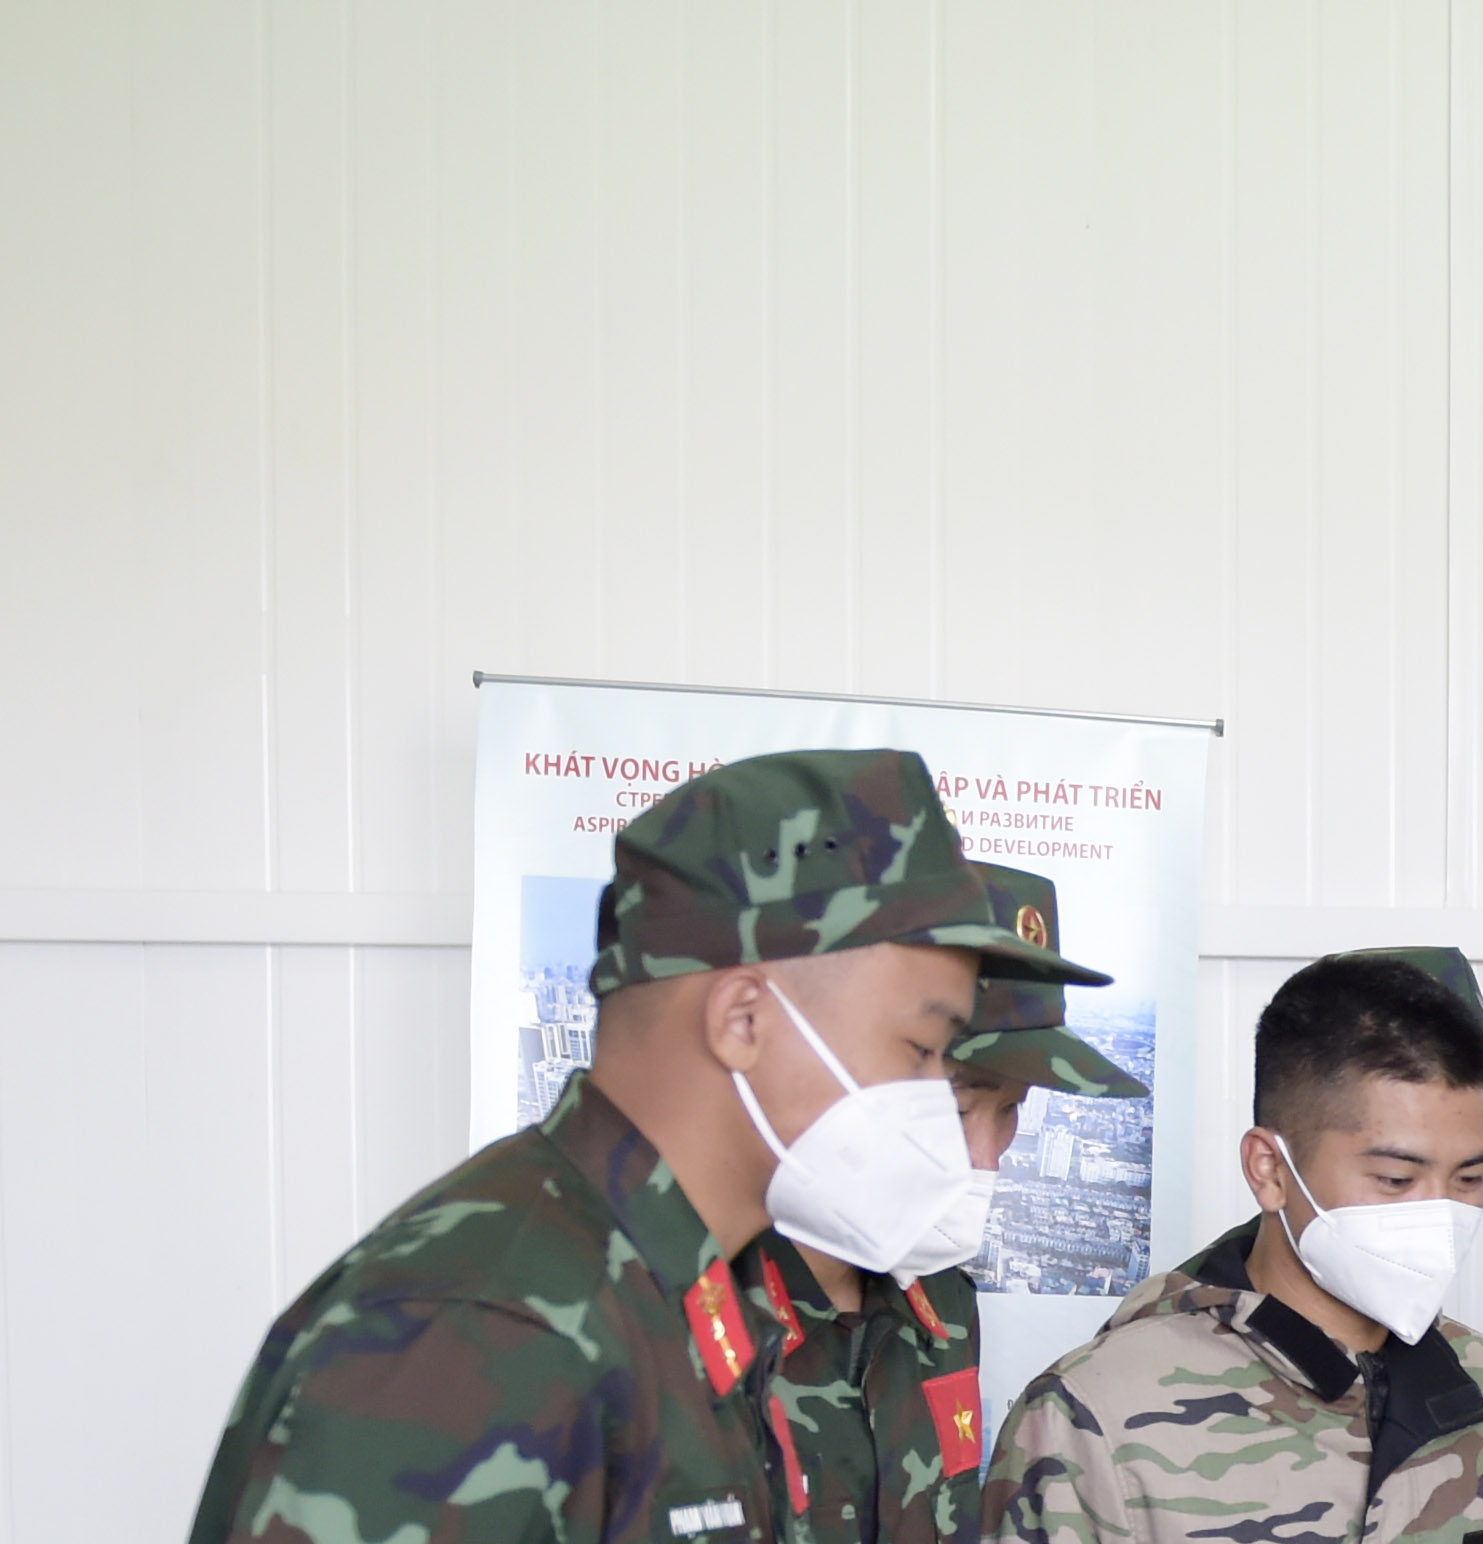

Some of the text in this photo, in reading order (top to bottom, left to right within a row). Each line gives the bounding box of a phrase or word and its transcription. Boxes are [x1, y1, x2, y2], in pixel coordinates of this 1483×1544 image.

[525, 751, 595, 778] KHÁT
[602, 757, 680, 786] VỌNG
[975, 774, 1008, 801] VÀ
[1016, 778, 1083, 805] PHÁT
[1089, 780, 1162, 810] TRIỂN
[962, 810, 974, 825] И
[980, 811, 1074, 832] РАЗВИТИЕ
[980, 837, 1114, 860] DEVELOPMENT
